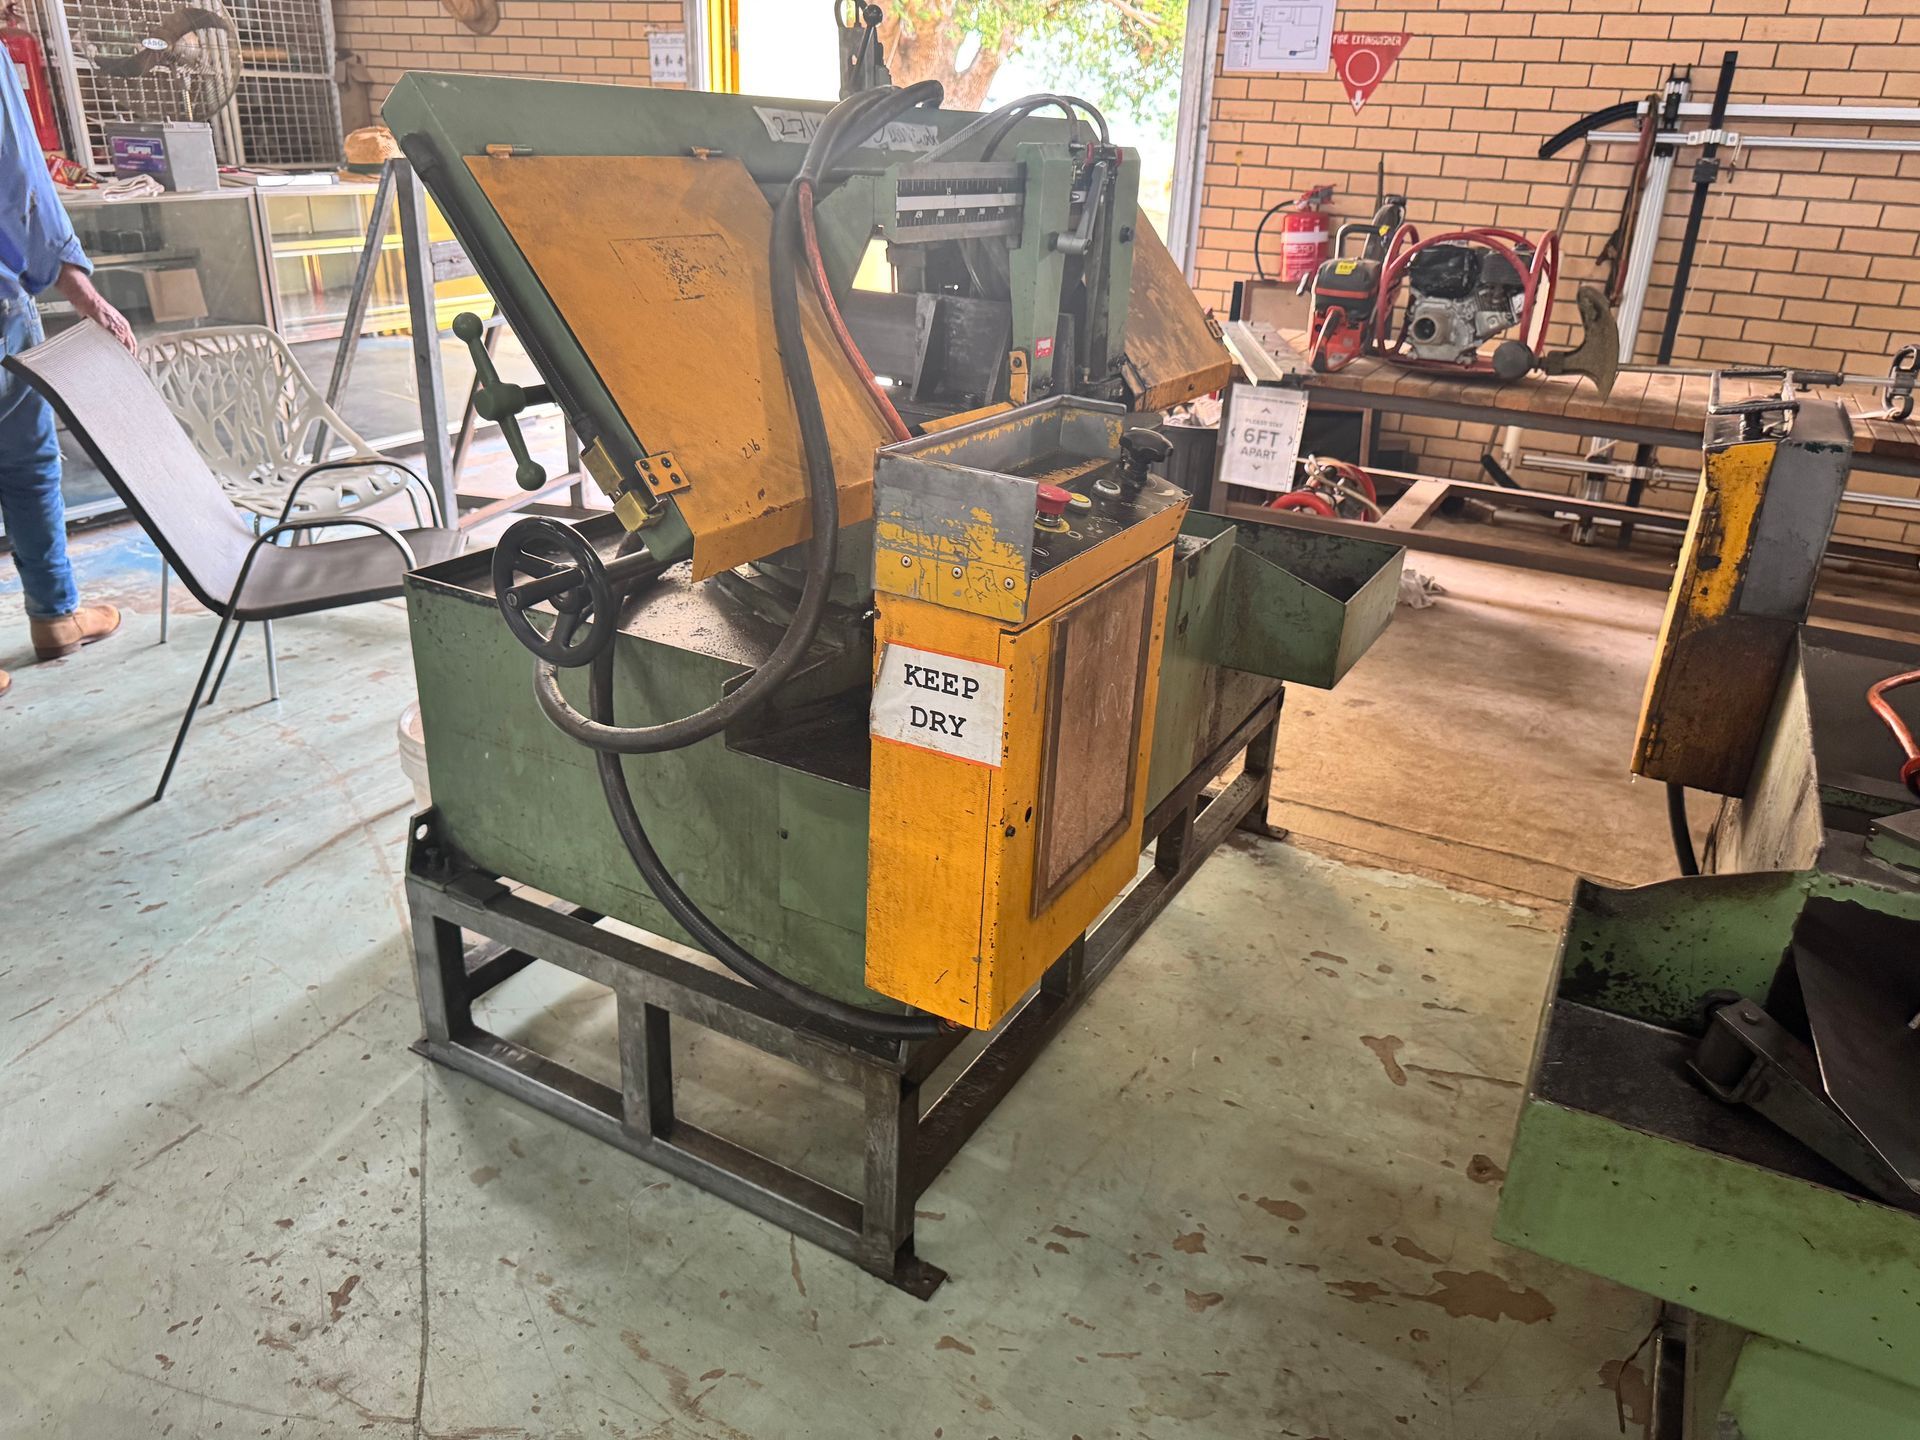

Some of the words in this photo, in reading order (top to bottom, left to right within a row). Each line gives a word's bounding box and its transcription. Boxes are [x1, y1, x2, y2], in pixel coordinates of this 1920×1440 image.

[1332, 34, 1350, 45] FIRE
[1350, 34, 1402, 46] EXTINGUISHER
[1243, 428, 1280, 448] 6FT
[1240, 446, 1278, 460] APART
[904, 663, 979, 699] KEEP
[910, 705, 967, 738] DRY
